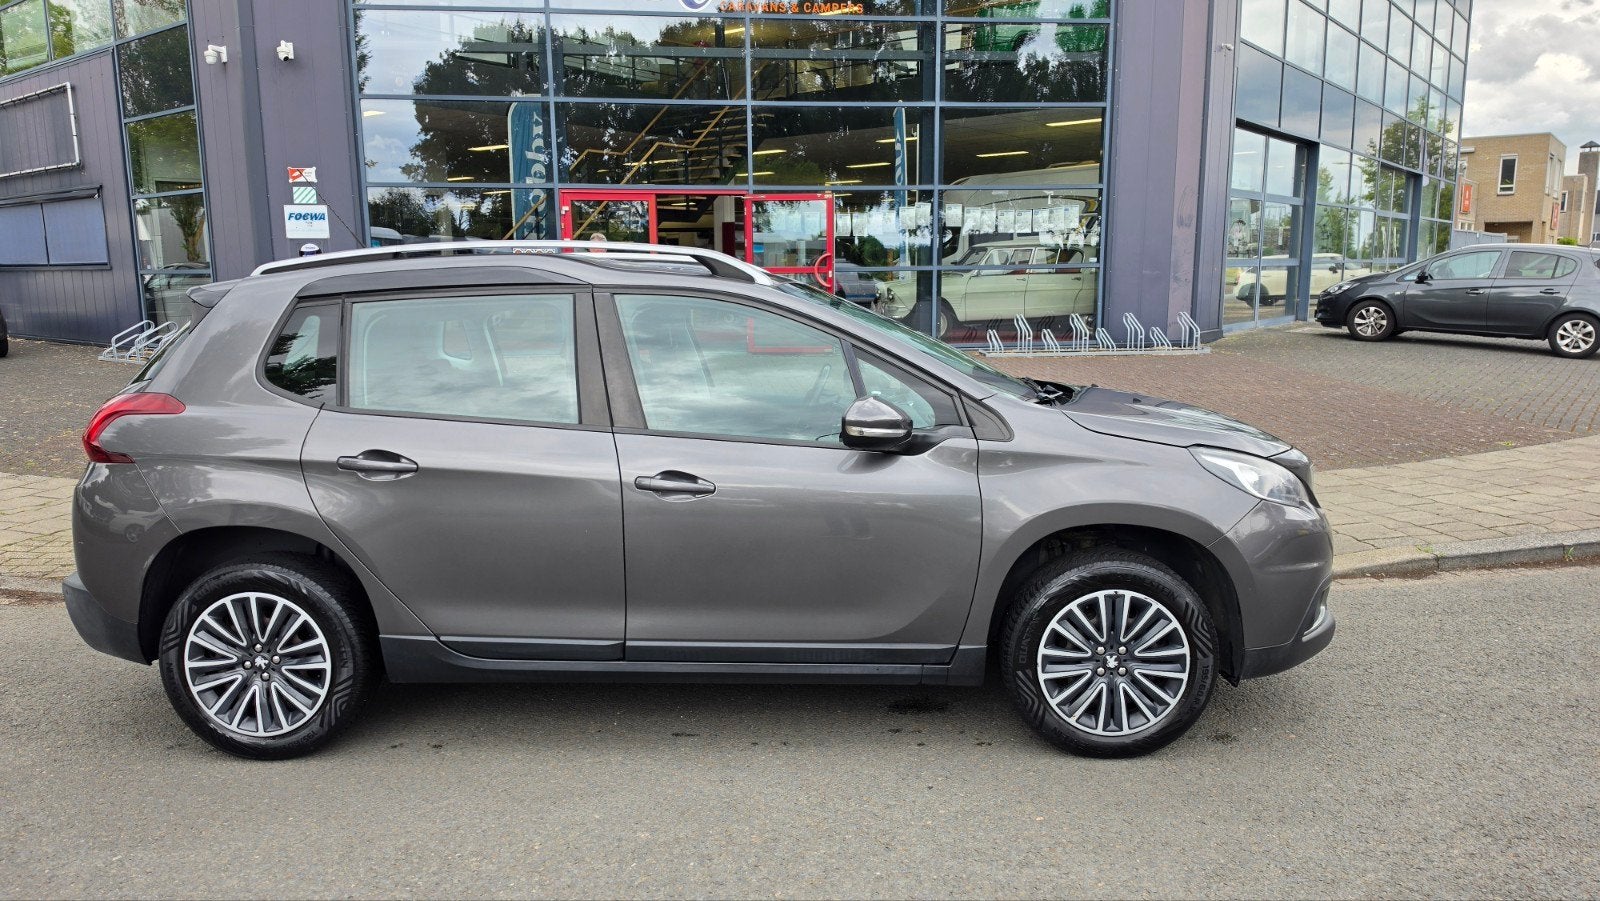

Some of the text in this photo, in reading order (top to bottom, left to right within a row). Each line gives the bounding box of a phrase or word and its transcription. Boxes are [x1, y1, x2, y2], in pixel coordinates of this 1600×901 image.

[719, 1, 863, 15] CARAVANS & CAMPERS
